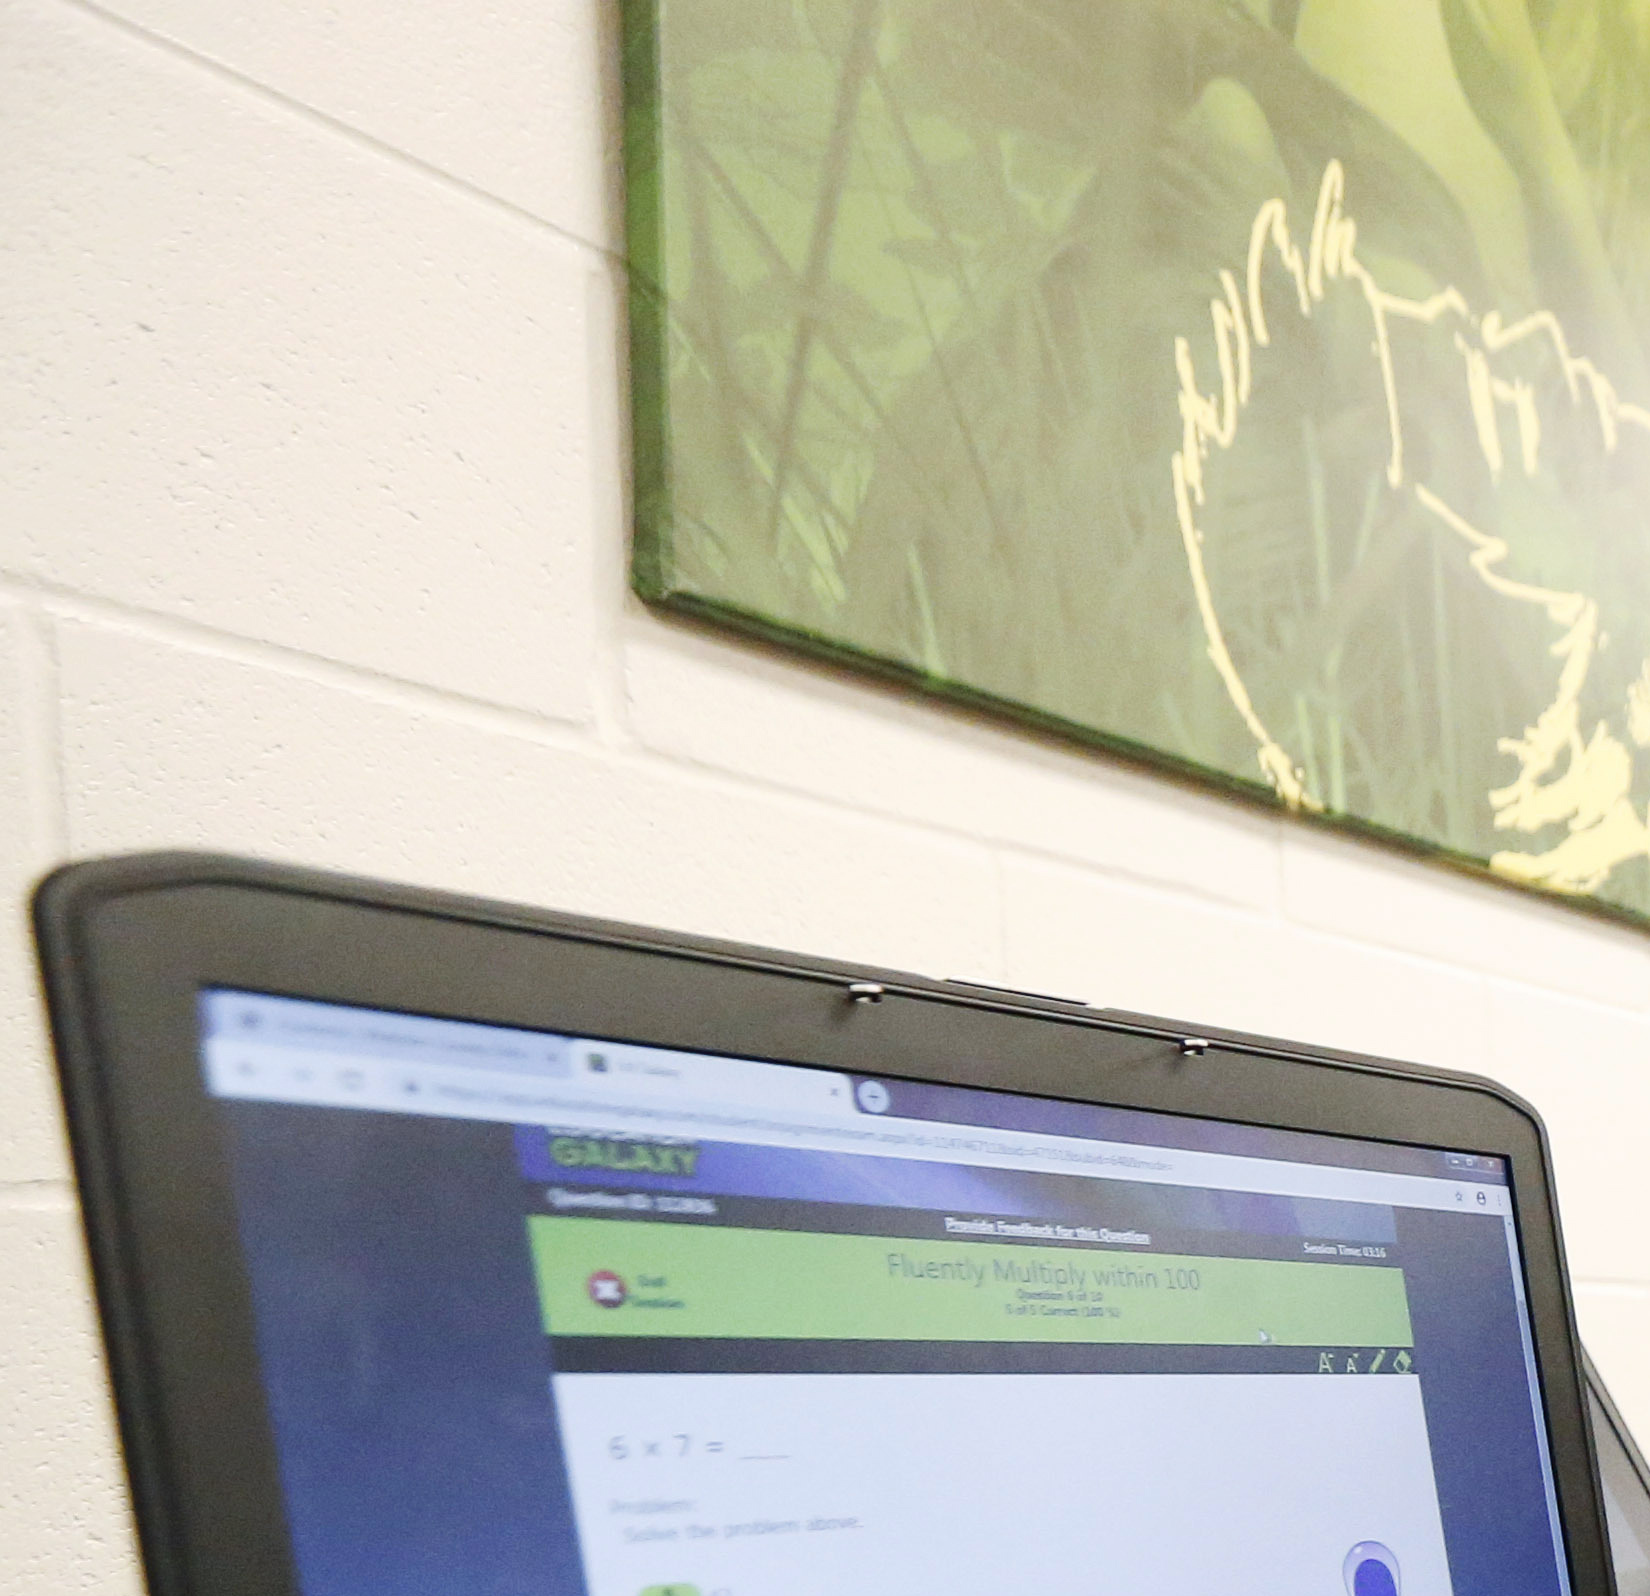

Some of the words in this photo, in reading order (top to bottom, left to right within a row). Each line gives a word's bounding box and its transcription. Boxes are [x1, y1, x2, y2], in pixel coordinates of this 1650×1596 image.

[1100, 1228, 1151, 1245] Question
[887, 1253, 984, 1288] Fluently
[993, 1258, 1087, 1290] Multiply
[1092, 1264, 1158, 1290] within
[1166, 1267, 1200, 1291] 100
[608, 1434, 630, 1460] 6
[673, 1432, 692, 1458] 7
